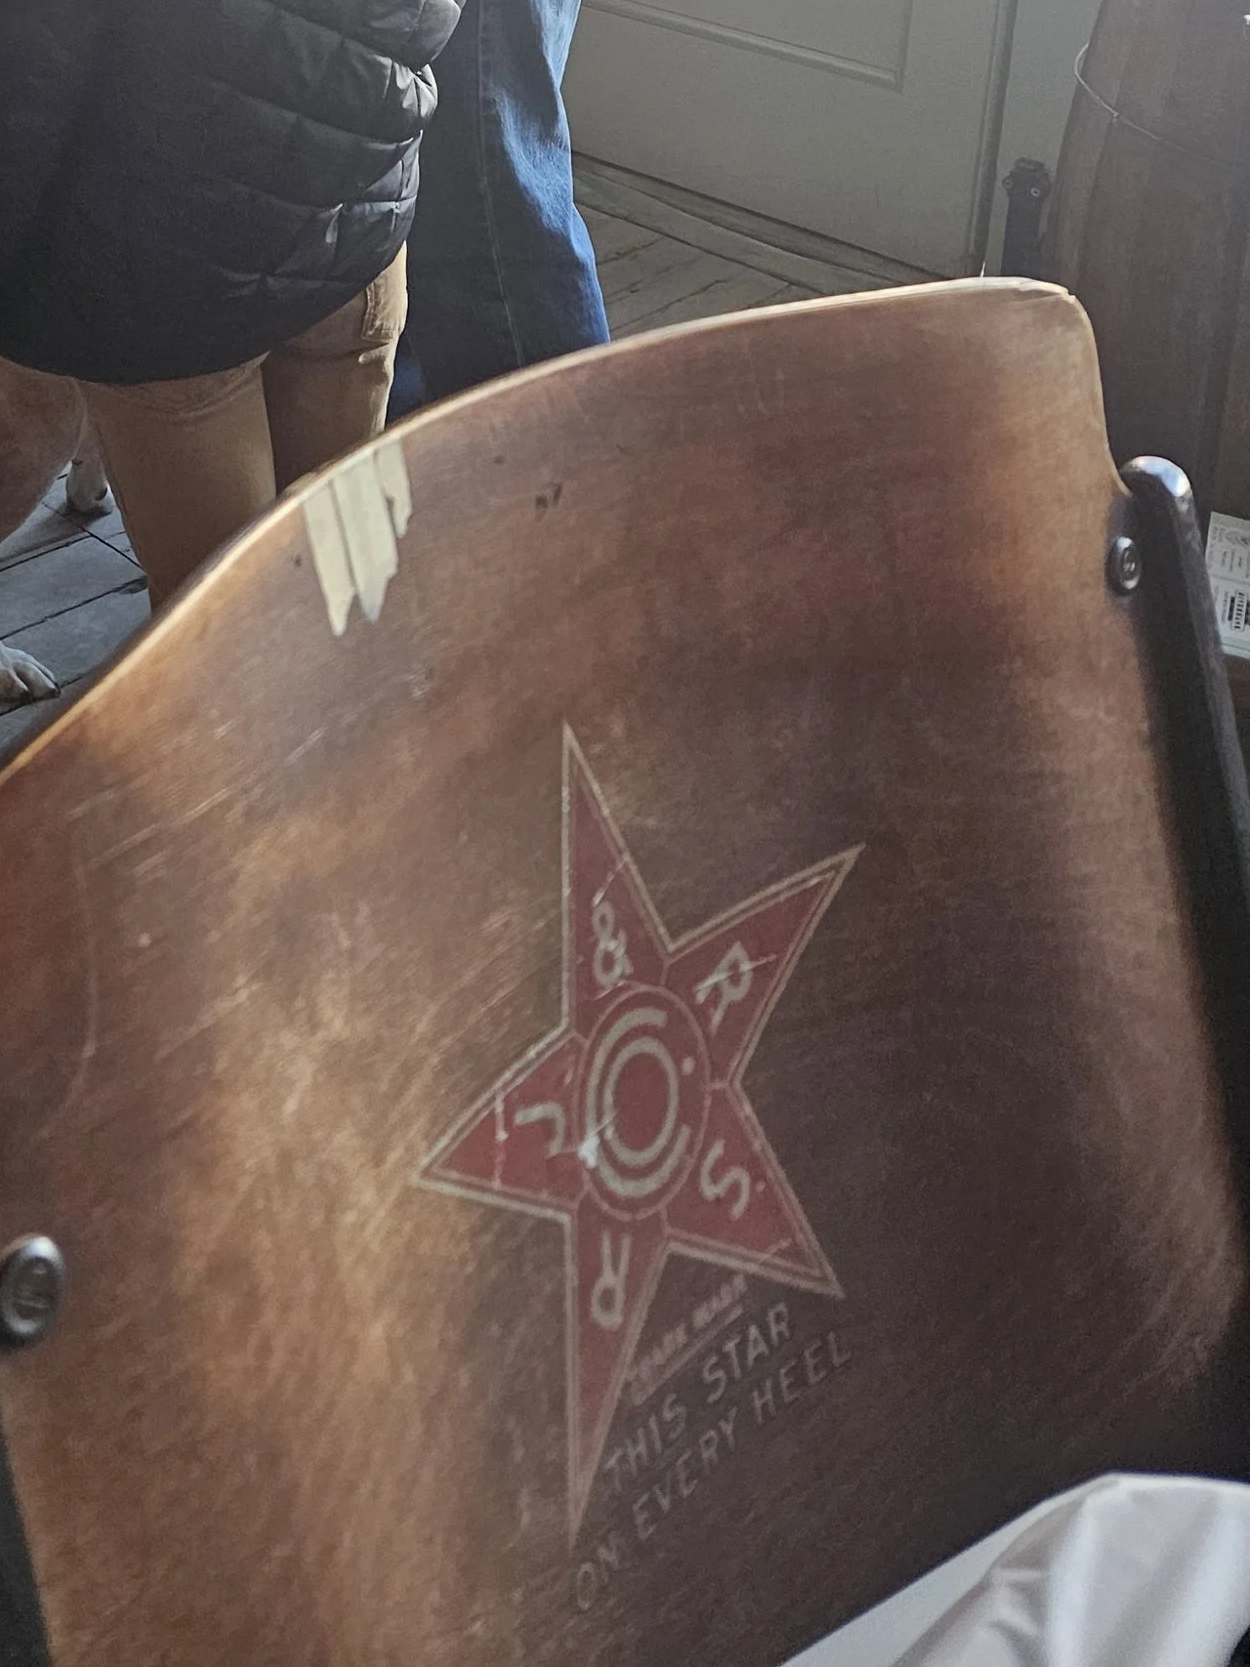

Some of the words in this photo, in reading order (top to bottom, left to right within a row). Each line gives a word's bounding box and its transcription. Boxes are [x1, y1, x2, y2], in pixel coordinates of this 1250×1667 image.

[575, 1531, 622, 1612] ON
[632, 1406, 739, 1541] EVERY
[751, 1330, 852, 1426] HEEL
[604, 1392, 687, 1494] THIS
[701, 1301, 791, 1405] STAR
